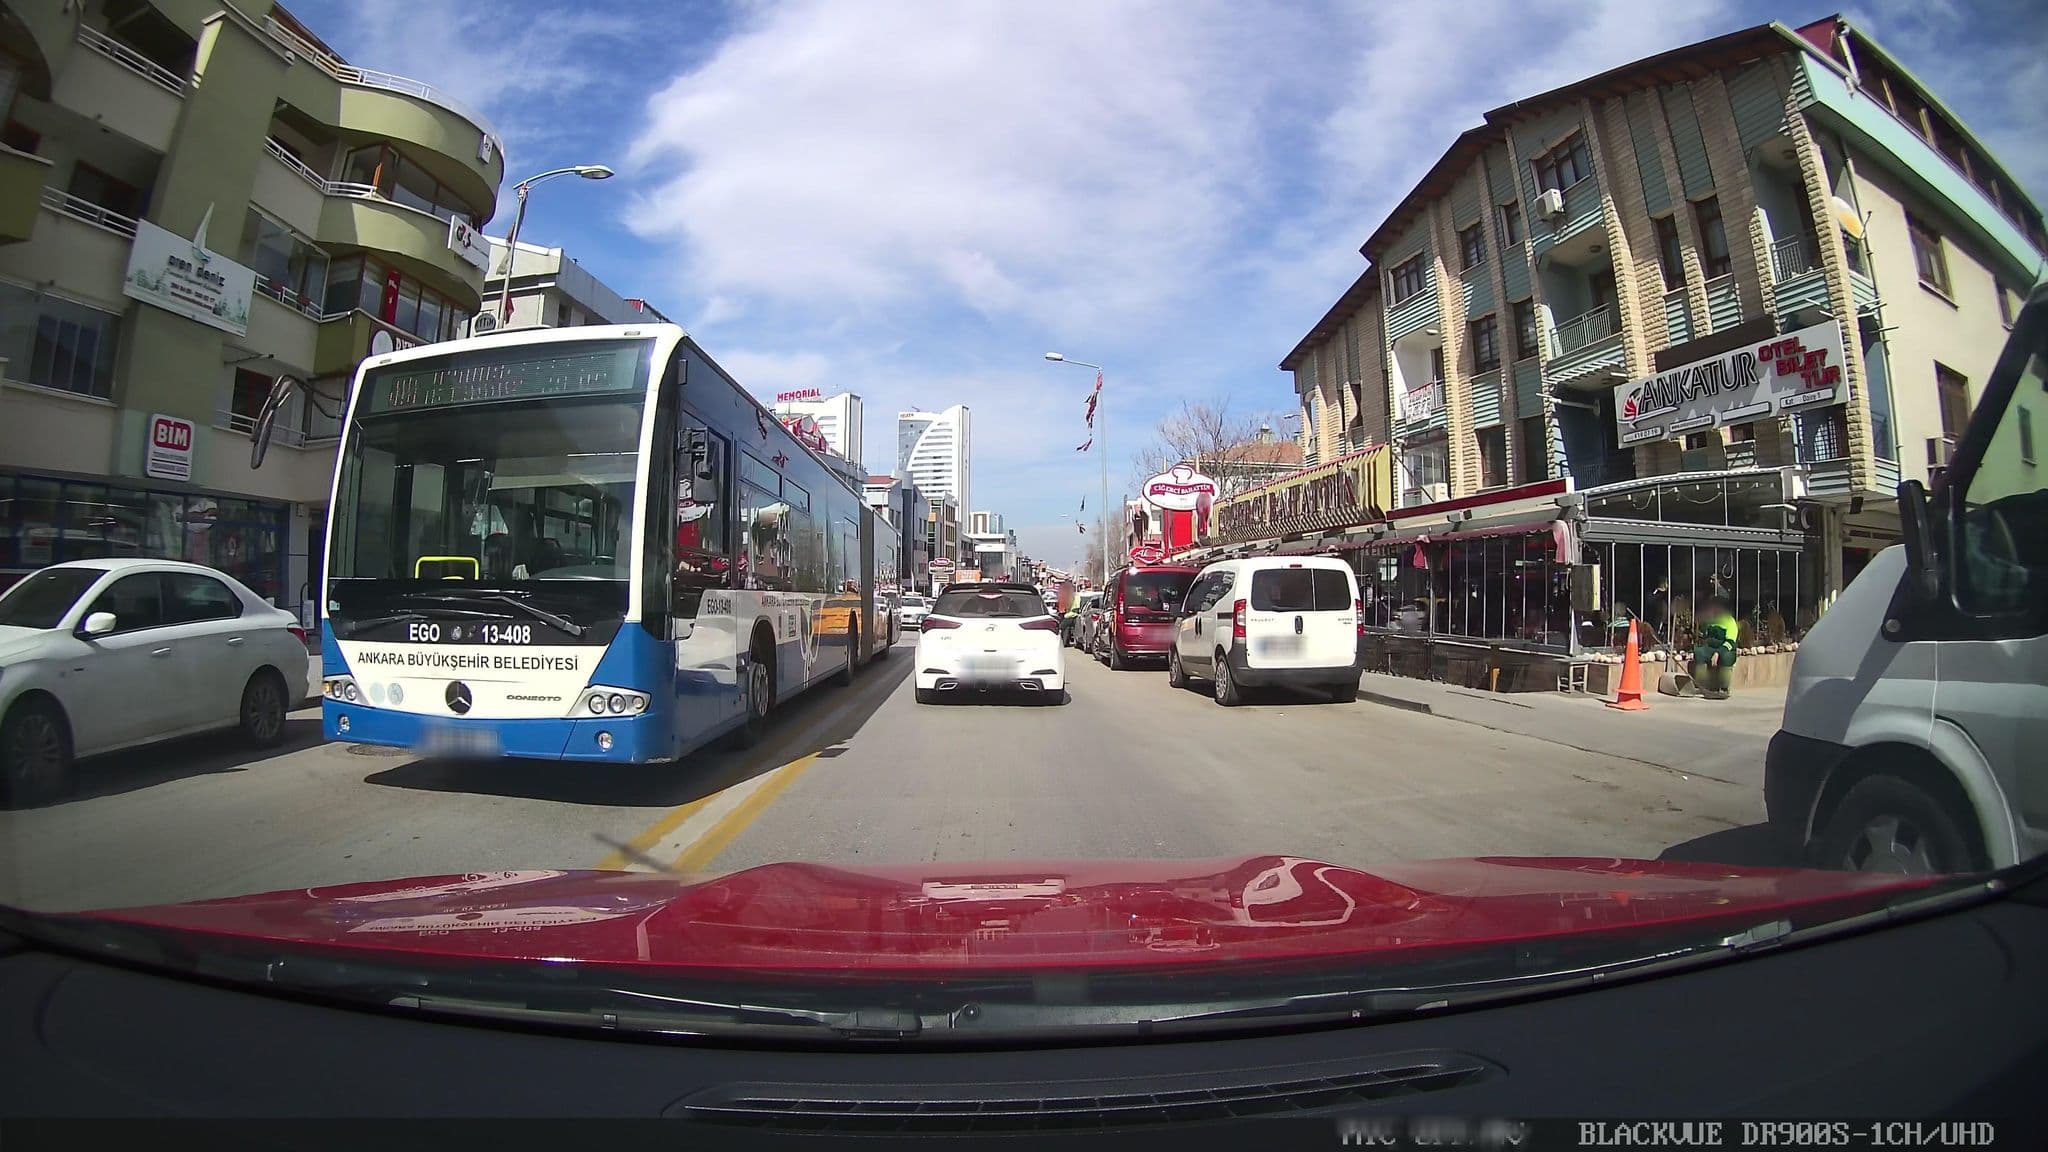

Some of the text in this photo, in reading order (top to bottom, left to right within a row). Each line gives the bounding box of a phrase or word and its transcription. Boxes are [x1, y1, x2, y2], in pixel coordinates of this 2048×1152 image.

[1758, 336, 1806, 362] OTEL
[1641, 352, 1759, 413] ANKATUR
[1801, 365, 1841, 388] TUR
[777, 388, 821, 402] MEMORIAL
[409, 623, 531, 644] EGO 13-408
[358, 651, 578, 671] ANKARA BÜYÜKŞEHİR BELEDİYESİ
